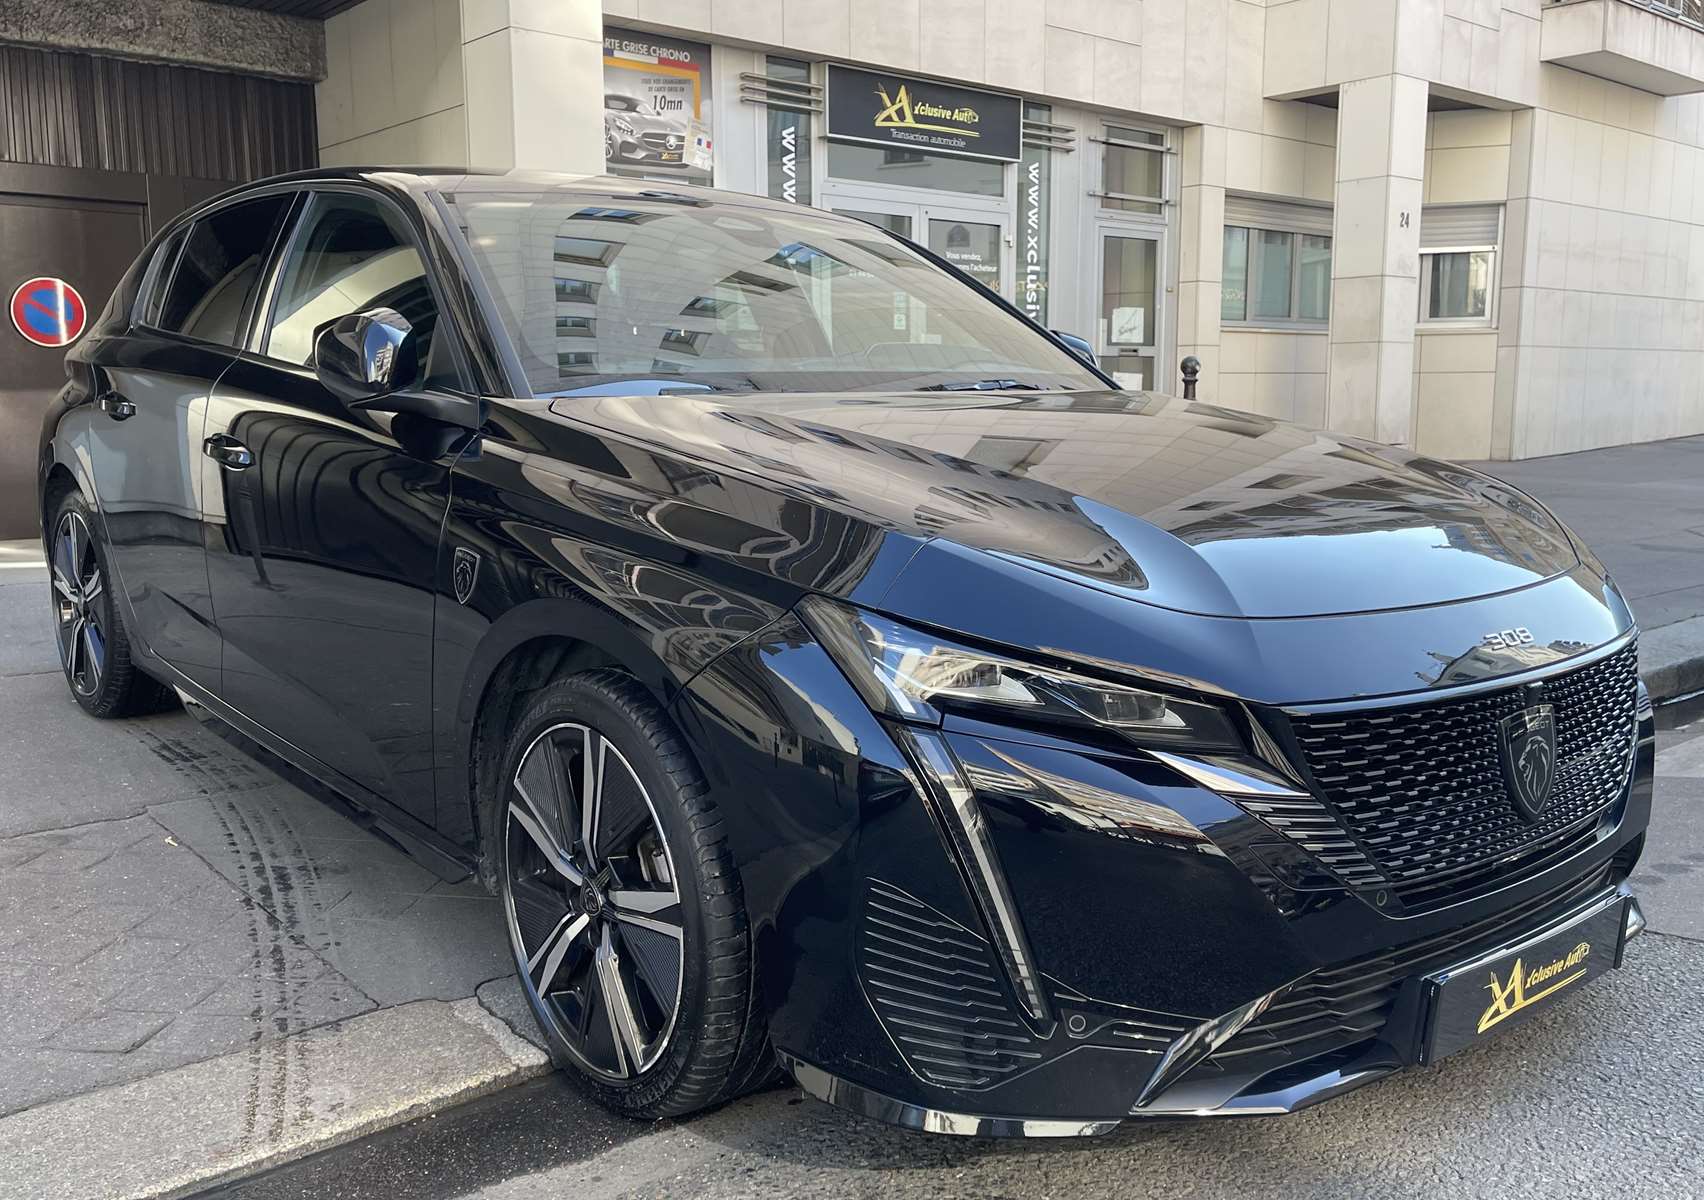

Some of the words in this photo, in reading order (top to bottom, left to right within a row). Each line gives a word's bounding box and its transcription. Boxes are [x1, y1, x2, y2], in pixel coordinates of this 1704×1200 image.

[603, 37, 620, 50] RTE
[622, 41, 649, 56] GRISE
[650, 46, 691, 62] CHRONO
[653, 95, 683, 110] 10mn
[890, 128, 929, 142] Transaction
[930, 136, 966, 147] automobile
[1400, 212, 1410, 228] 24
[945, 251, 960, 259] Vous
[1483, 627, 1534, 651] 308
